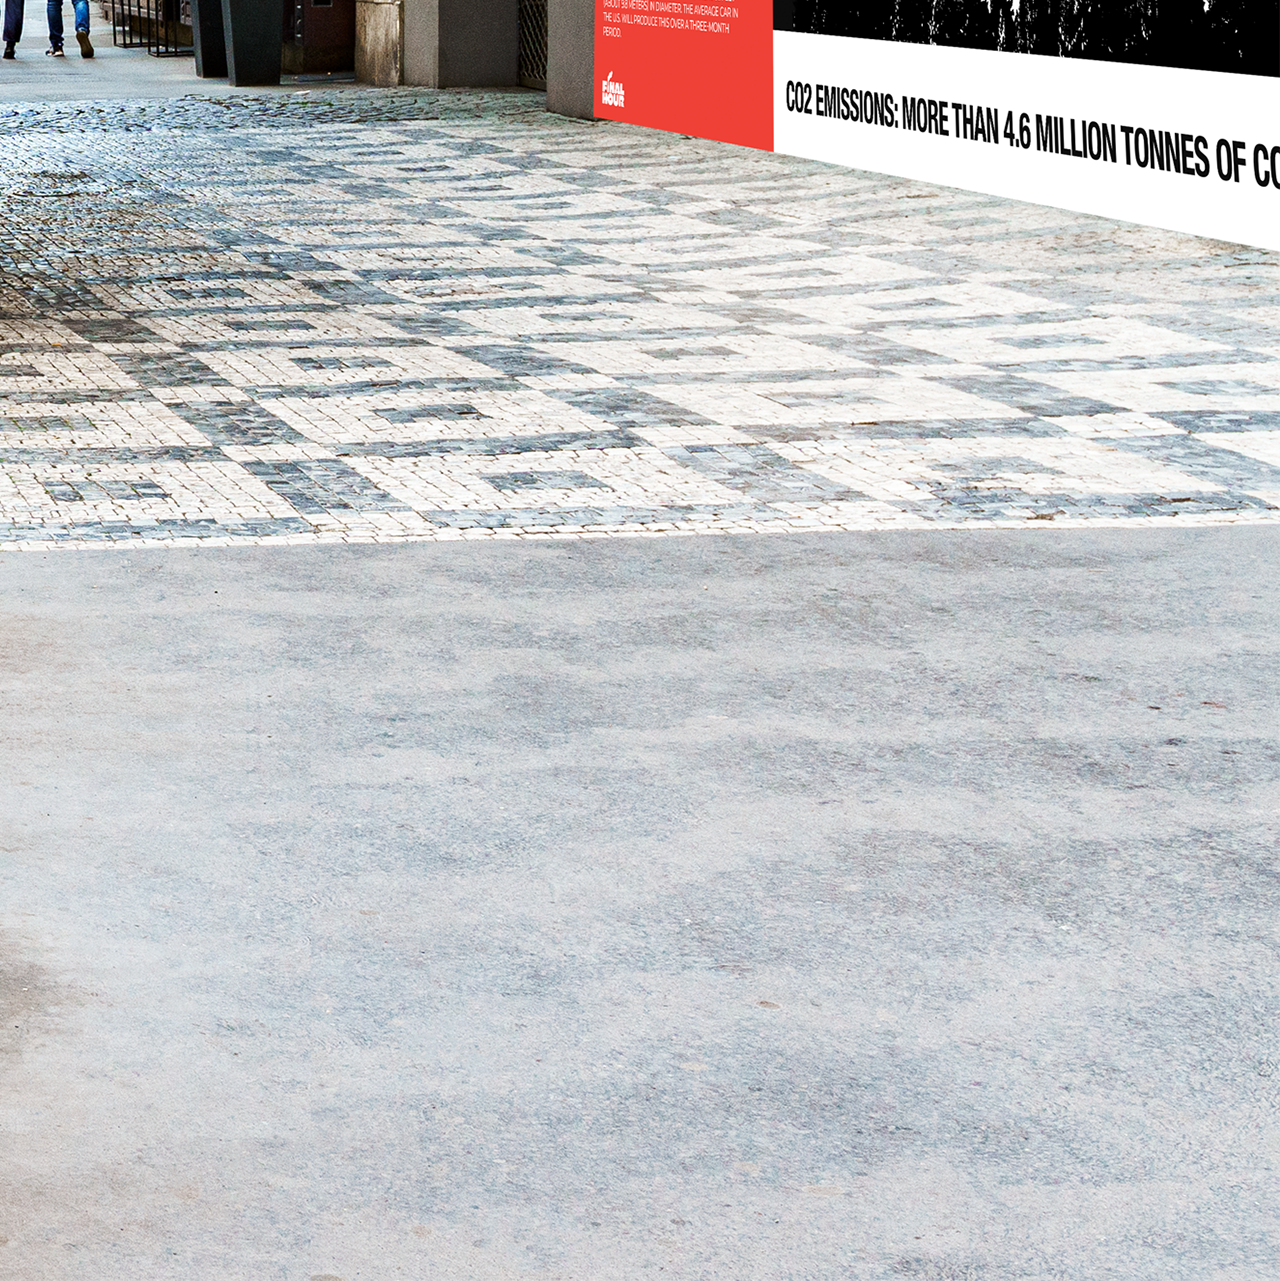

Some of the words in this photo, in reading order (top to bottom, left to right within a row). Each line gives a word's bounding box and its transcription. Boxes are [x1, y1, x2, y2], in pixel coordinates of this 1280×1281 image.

[602, 77, 625, 96] FINAL
[602, 92, 625, 108] HOUR
[786, 80, 813, 115] CO2
[816, 84, 899, 129] EMISSIONS:
[902, 96, 950, 137] MORE
[952, 103, 999, 145] THAN
[1003, 110, 1032, 150] 4.6
[1036, 114, 1117, 164] MILLION
[1120, 125, 1210, 178] TONNES
[1216, 138, 1247, 183] OF
